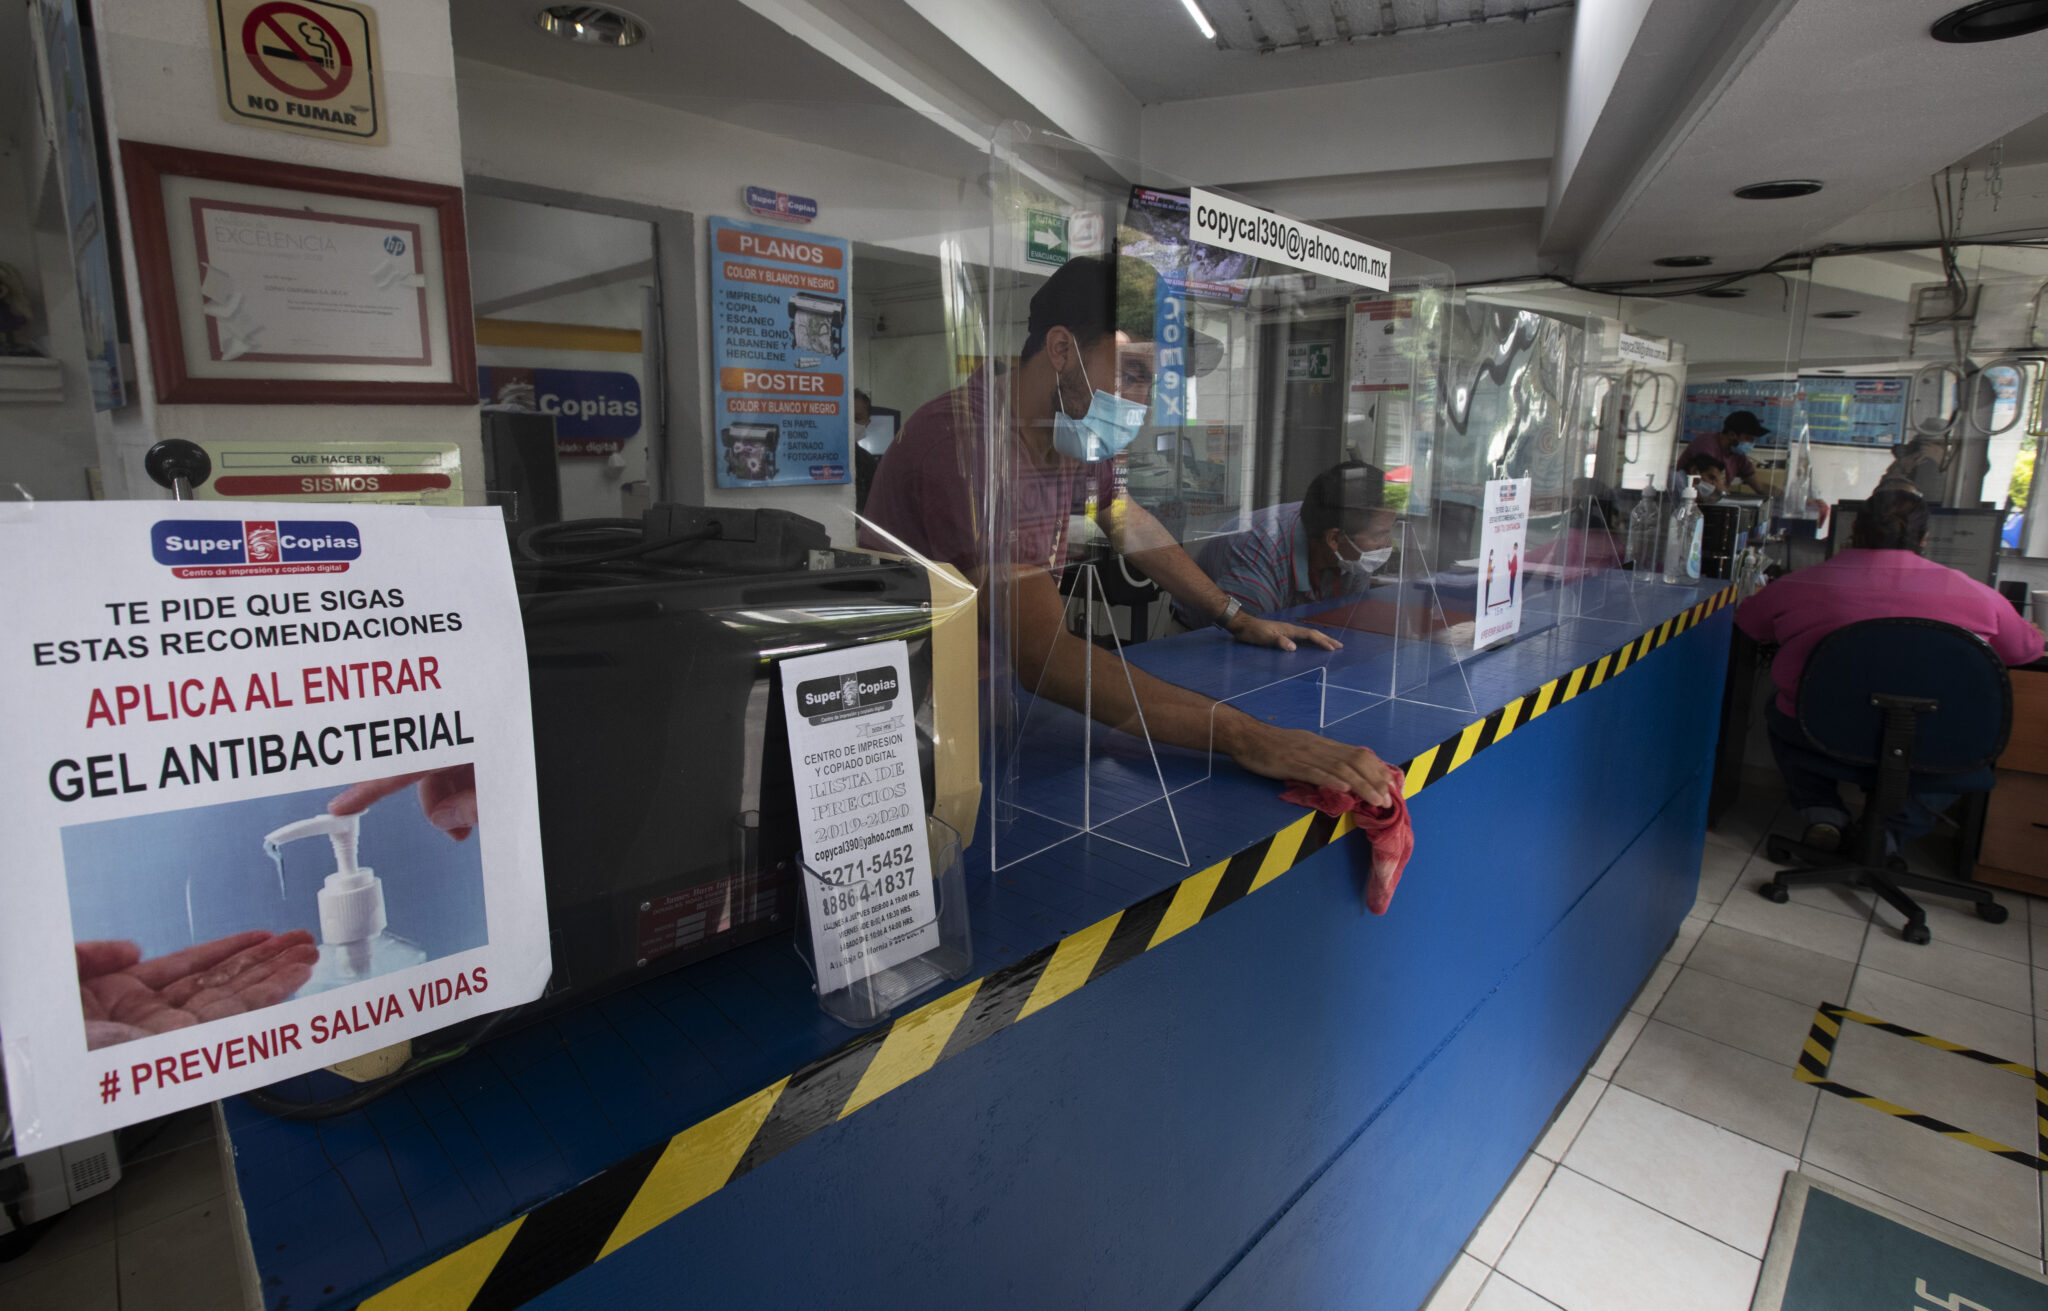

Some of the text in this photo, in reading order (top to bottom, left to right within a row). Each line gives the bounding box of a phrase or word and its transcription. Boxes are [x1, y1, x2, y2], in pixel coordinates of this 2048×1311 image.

[247, 94, 358, 127] NO FUMAR
[752, 194, 816, 213] Super Copias
[215, 226, 338, 252] EXCELENCIA
[740, 235, 824, 264] PLANOS
[1197, 204, 1388, 280] copycal390@yahoo.com.mx
[727, 265, 836, 290] COLOR Y BLANCO Y NEGRO
[726, 290, 781, 305] IMPRESIÓN
[726, 302, 757, 314] COPIA
[726, 314, 775, 326] ESCANEO
[727, 326, 759, 338] PAPEL
[726, 338, 788, 350] ALBANENE Y
[726, 350, 787, 362] HERCULENE
[743, 372, 825, 392] POSTER
[540, 393, 639, 421] Copias
[730, 400, 836, 414] COLOR Y BLANCO Y NEGRO
[291, 453, 386, 465] QUE HACER EN:
[302, 476, 379, 492] SISMOS
[165, 534, 359, 554] Super Copias
[182, 563, 342, 577] Centro de impresión y copiado digital
[105, 588, 404, 626] TE PIDE QUE SIGAS
[33, 612, 463, 667] ESTAS RECOMENDACIONES
[85, 655, 442, 728] APLICA AL ENTRAR
[805, 679, 897, 705] Super Copias
[48, 710, 474, 802] GEL ANTIBACTERIAL
[804, 734, 903, 765] CENTRO DE IMPRESION
[815, 749, 897, 777] Y COPIADO DIGITAL
[808, 762, 905, 799] LISTA DE
[812, 783, 907, 821] PRECIOS
[815, 803, 910, 843] 2019-2020
[814, 822, 914, 862] copycal390@yahoo.com.mx
[909, 890, 920, 899] HRS.
[900, 905, 913, 914] HRS.
[902, 916, 914, 926] HRS.
[99, 966, 489, 1103] # PREVENIR SALVA VIDAS
